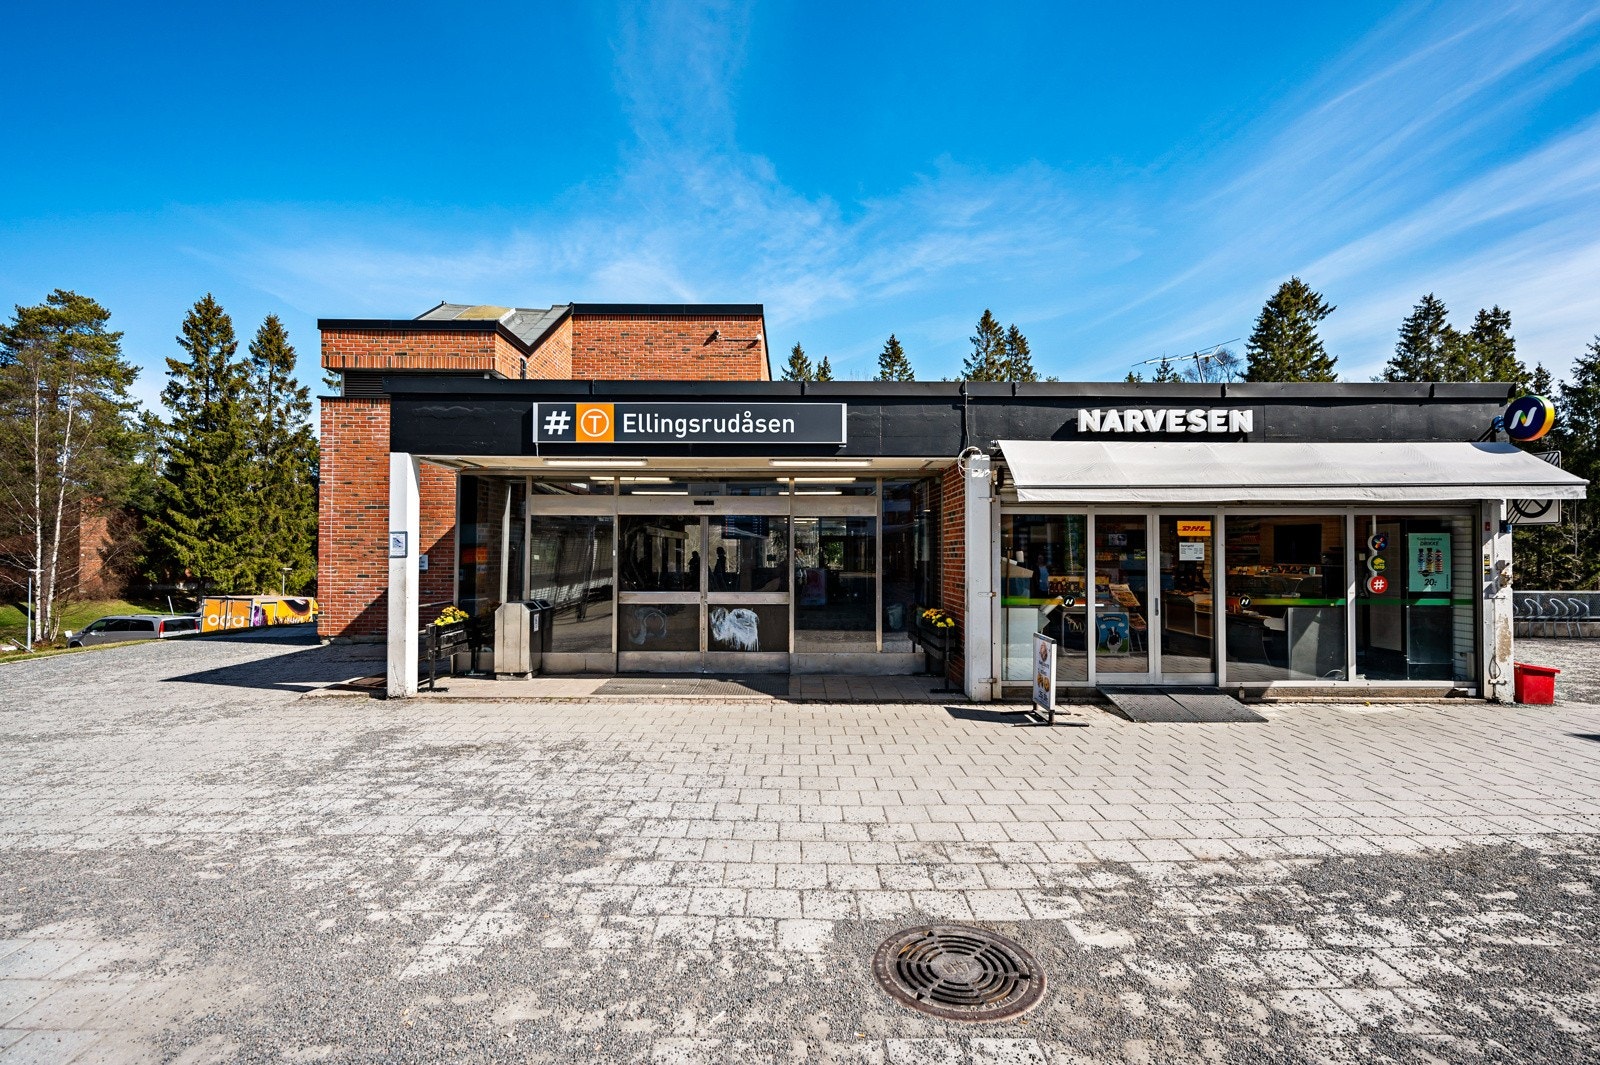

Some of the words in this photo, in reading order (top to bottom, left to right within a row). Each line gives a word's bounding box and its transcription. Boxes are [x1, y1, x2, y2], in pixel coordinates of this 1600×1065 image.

[622, 410, 795, 438] Ellingsrudåsen
[1077, 408, 1254, 433] NARVESEN
[207, 612, 245, 628] oda
